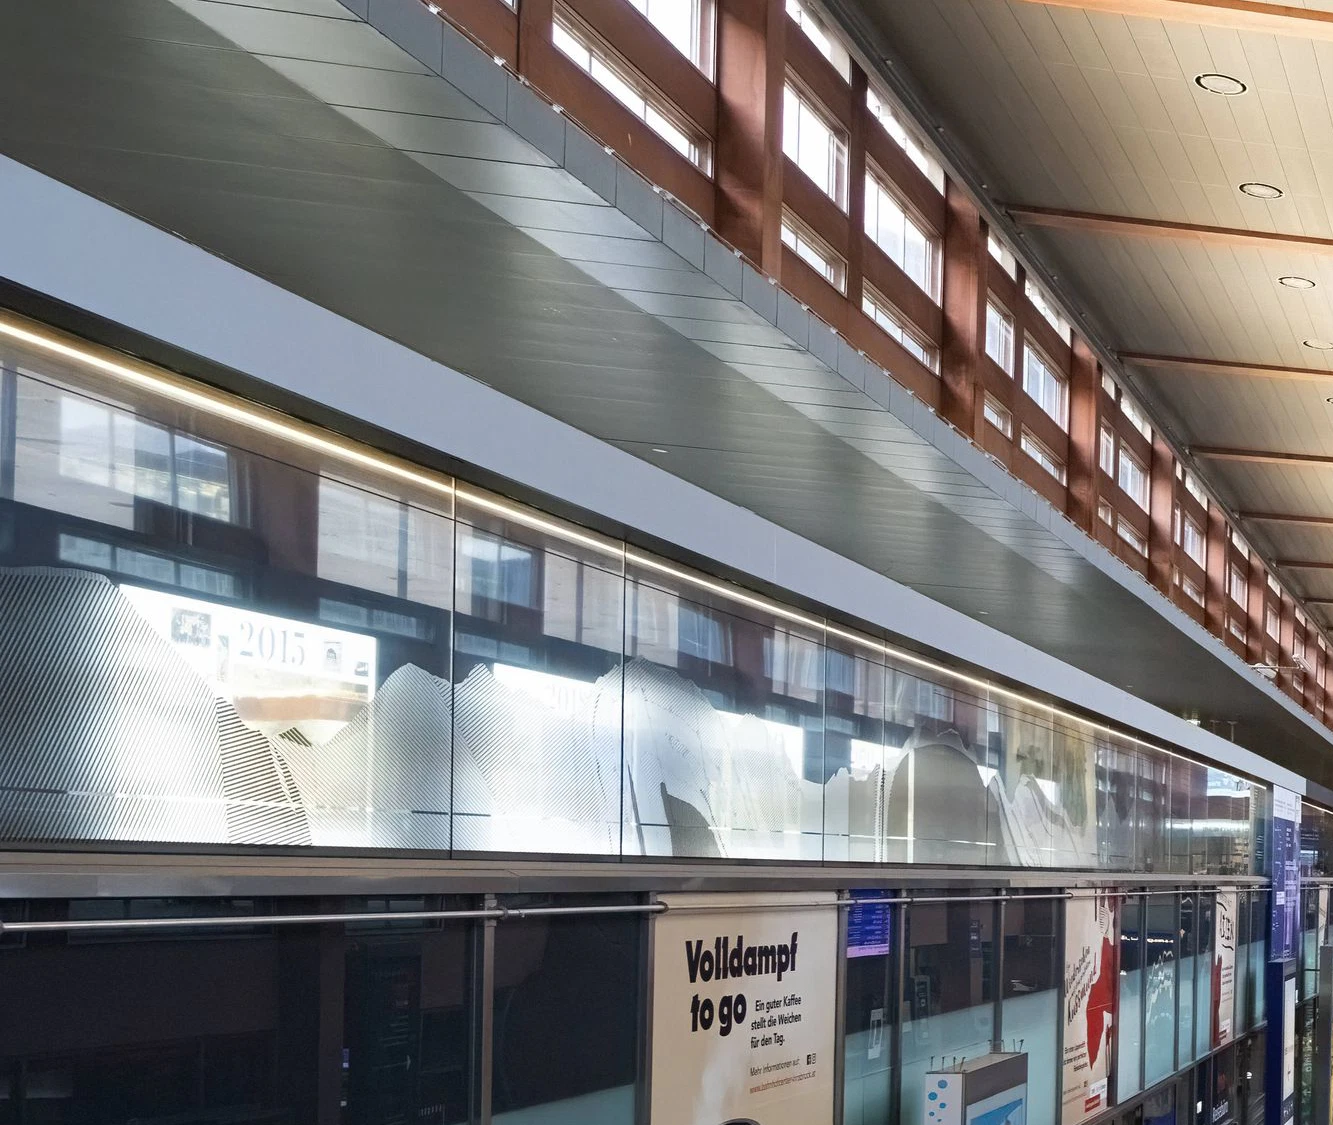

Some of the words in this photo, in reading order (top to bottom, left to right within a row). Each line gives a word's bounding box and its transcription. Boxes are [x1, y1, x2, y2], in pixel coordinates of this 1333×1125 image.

[685, 931, 798, 983] Volldampf
[755, 999, 765, 1011] Ein
[766, 999, 782, 1013] guter
[783, 994, 802, 1007] Kaffee
[690, 994, 714, 1032] to
[718, 993, 747, 1037] go
[751, 1017, 766, 1031] stellt
[767, 1016, 777, 1027] die
[778, 1012, 802, 1025] Weichen
[751, 1037, 760, 1049] für
[760, 1035, 772, 1047] den
[773, 1033, 785, 1046] Tag.
